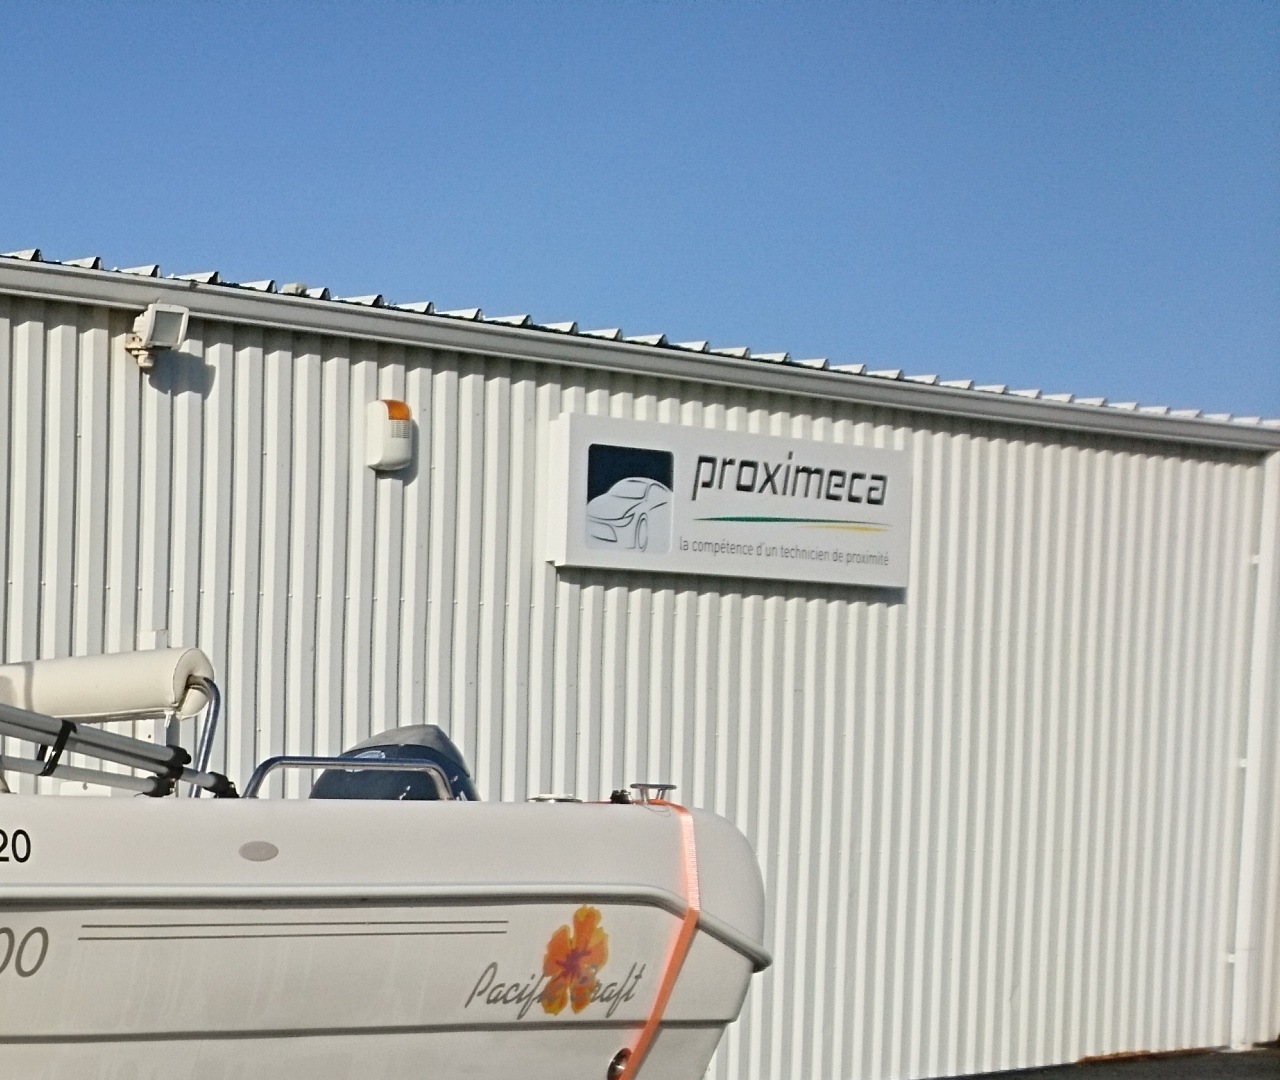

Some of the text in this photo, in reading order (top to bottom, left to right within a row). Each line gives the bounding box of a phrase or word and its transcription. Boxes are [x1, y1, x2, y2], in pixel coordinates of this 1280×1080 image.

[691, 451, 889, 506] proximeca
[679, 535, 889, 567] la compétence d'un technicien de proximité
